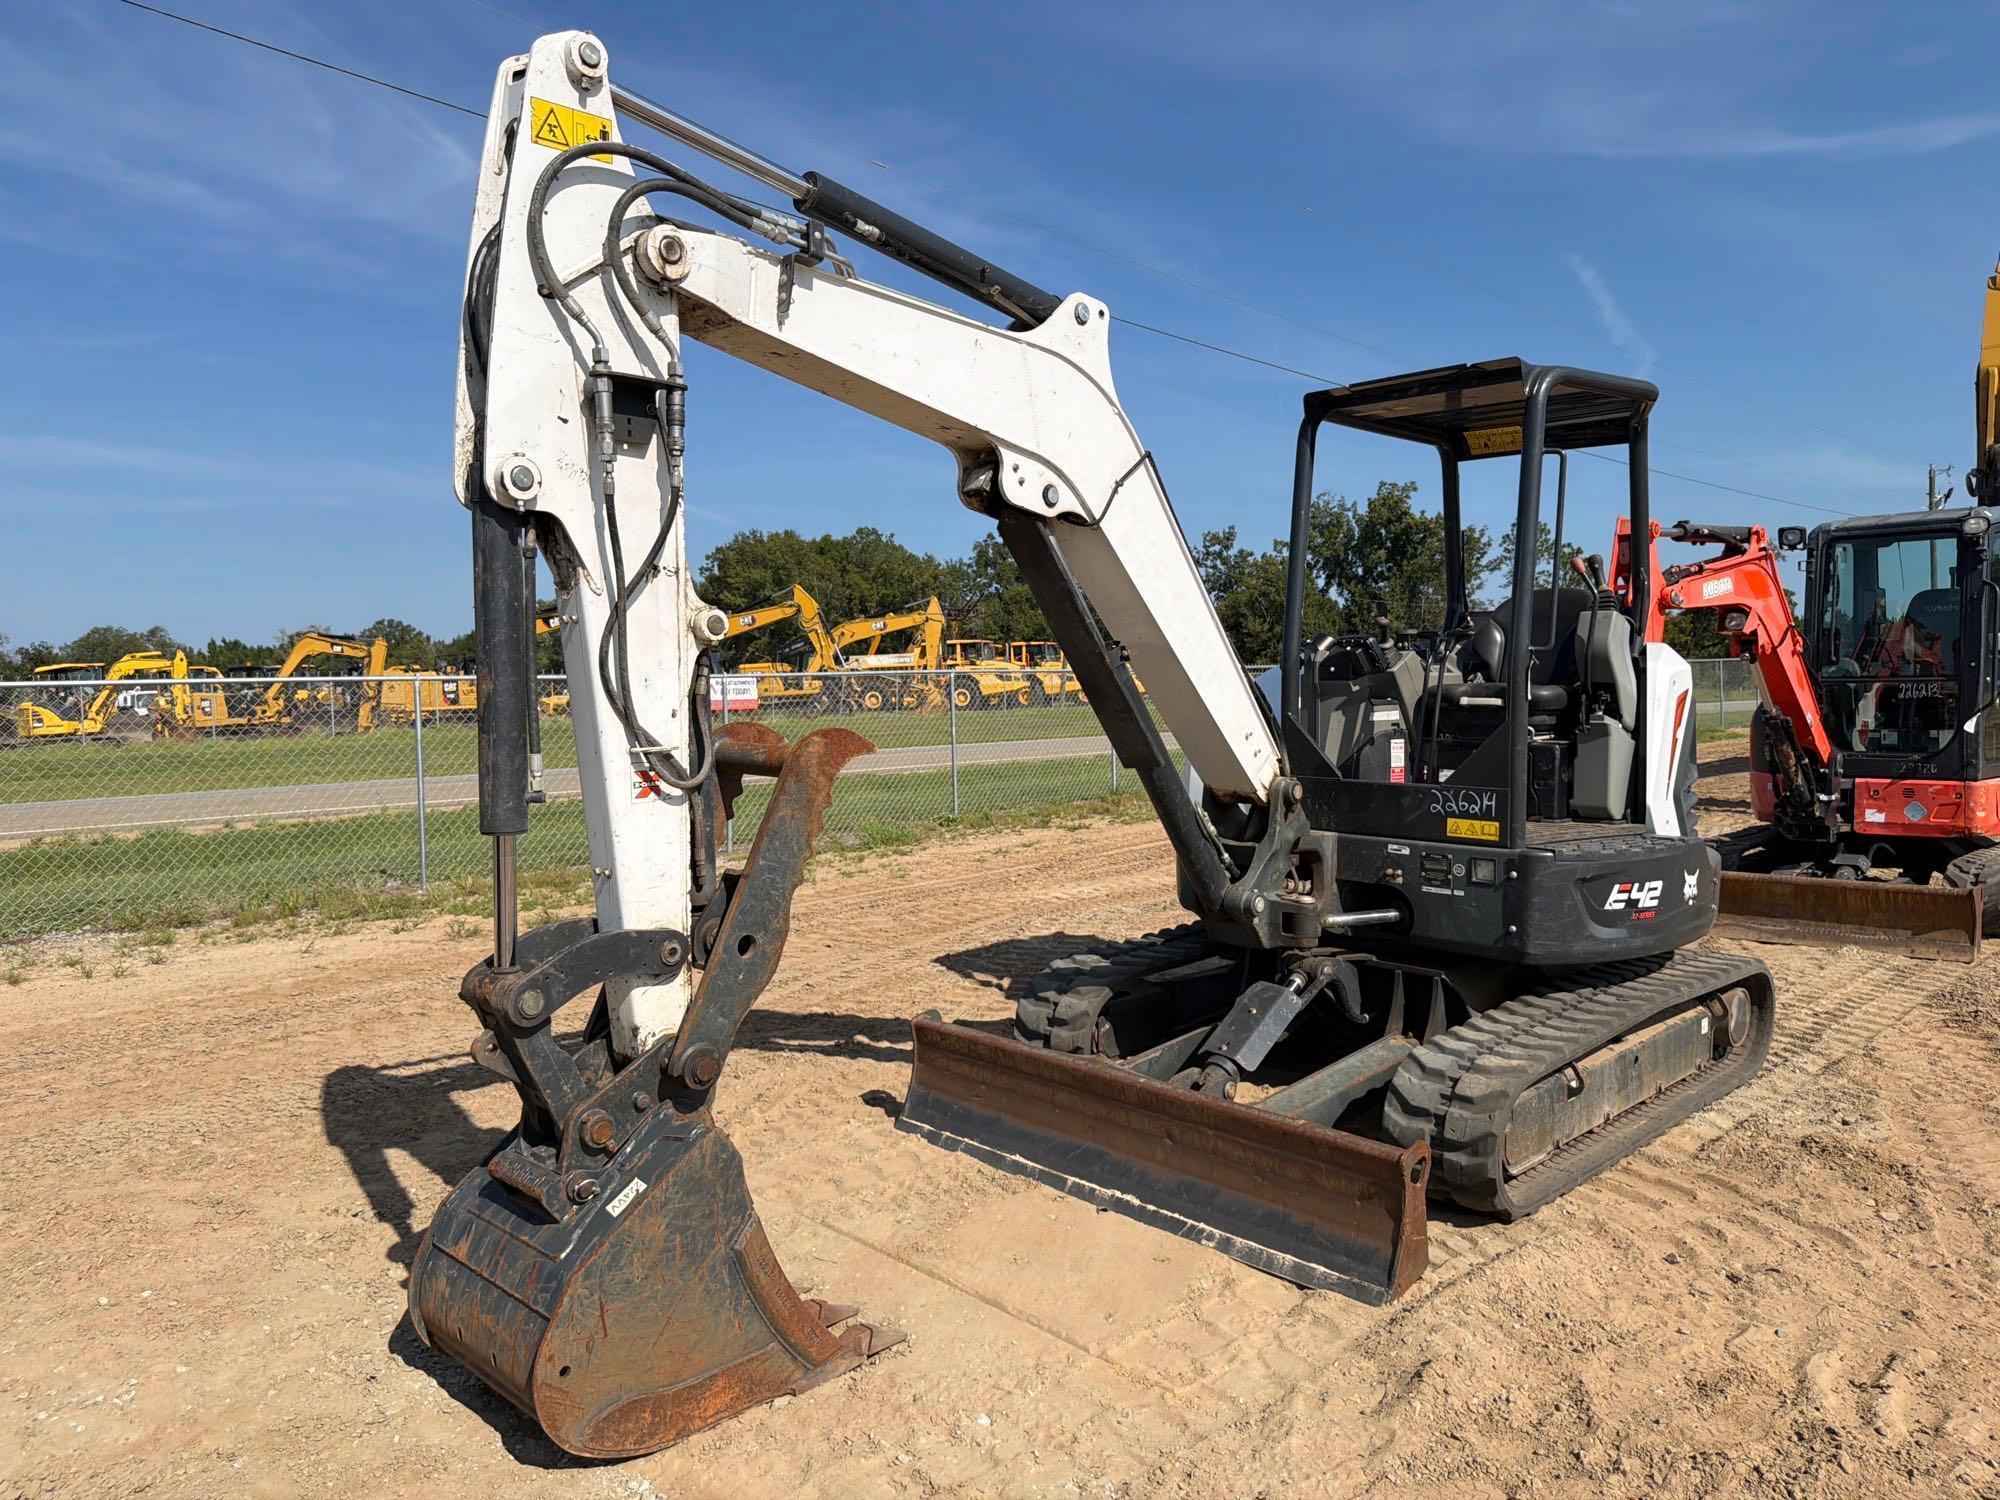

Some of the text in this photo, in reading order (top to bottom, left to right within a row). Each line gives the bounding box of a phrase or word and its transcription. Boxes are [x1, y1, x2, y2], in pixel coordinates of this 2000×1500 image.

[444, 682, 457, 692] CAT
[1898, 683, 1940, 699] 226213
[1430, 789, 1496, 818] 226214
[1603, 880, 1664, 910] E42
